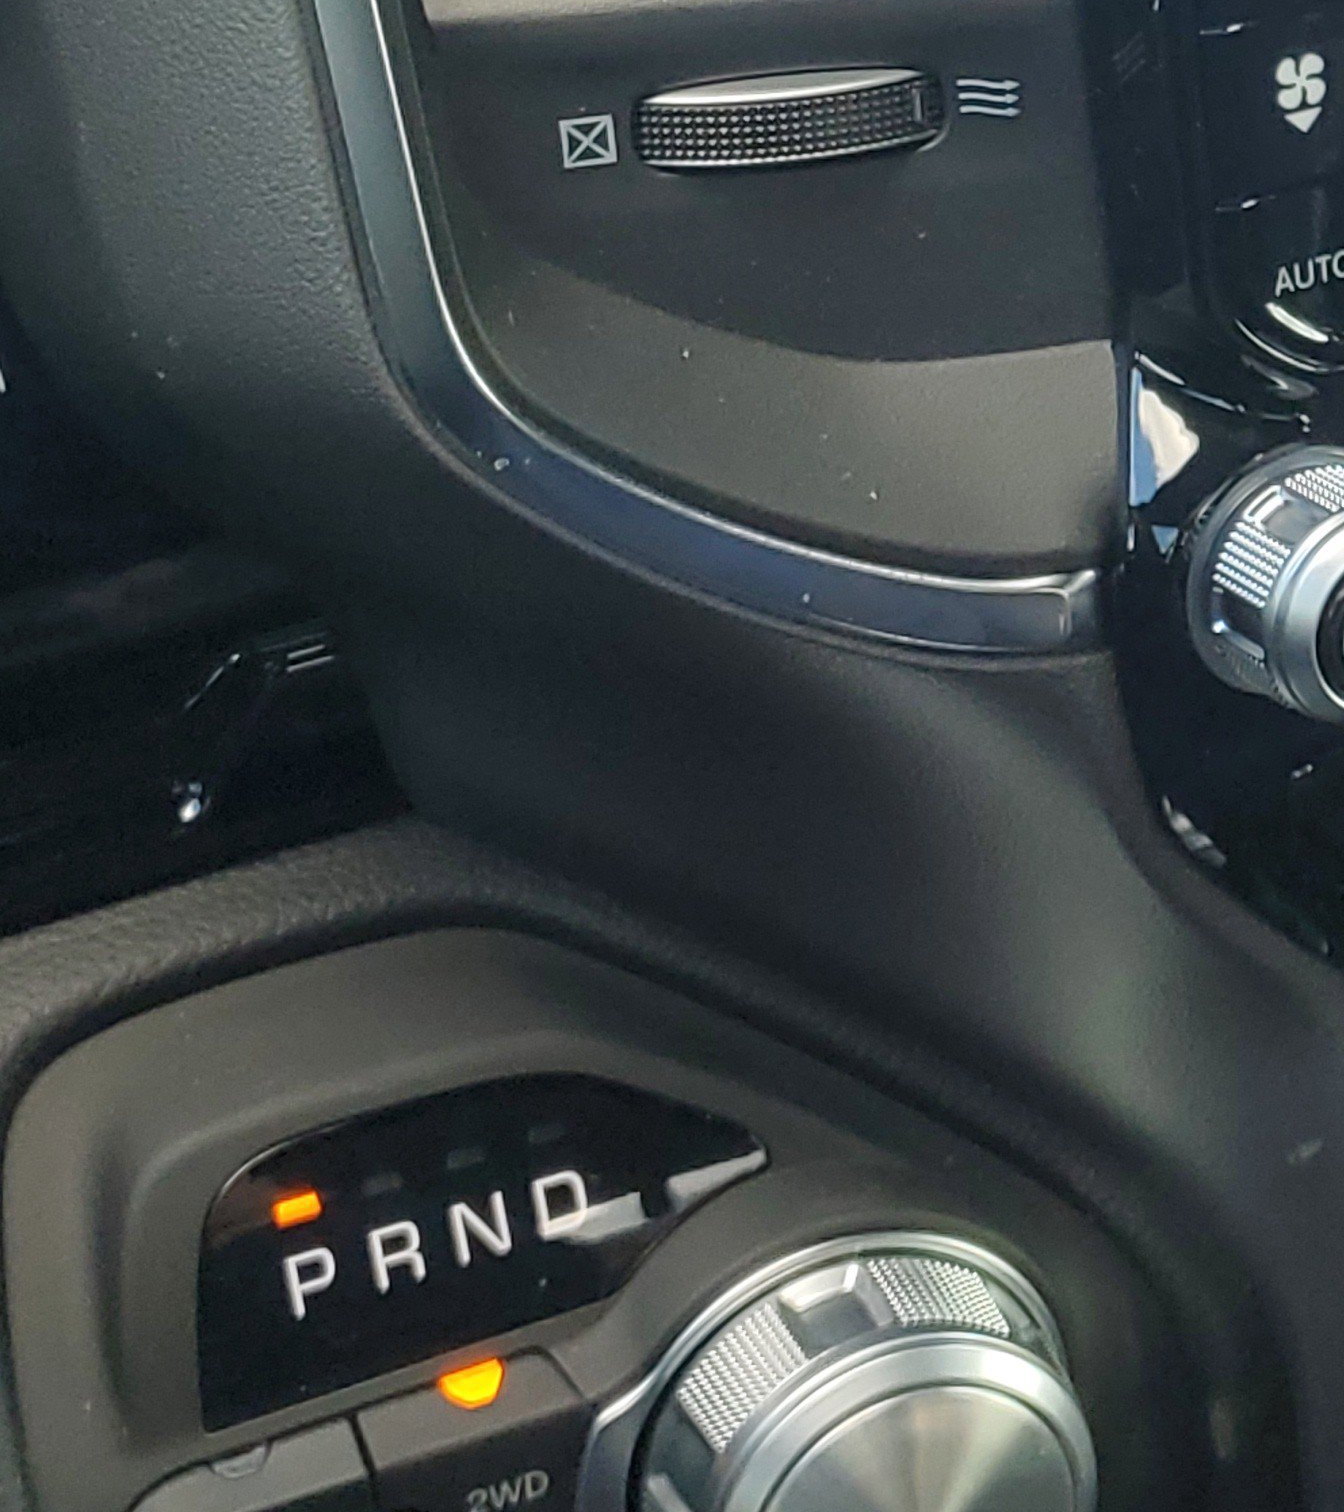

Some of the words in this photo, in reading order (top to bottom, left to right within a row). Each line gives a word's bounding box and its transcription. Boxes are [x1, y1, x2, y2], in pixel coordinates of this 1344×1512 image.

[282, 1246, 337, 1322] P
[366, 1220, 427, 1295] R
[447, 1189, 514, 1268] N
[530, 1168, 590, 1242] D
